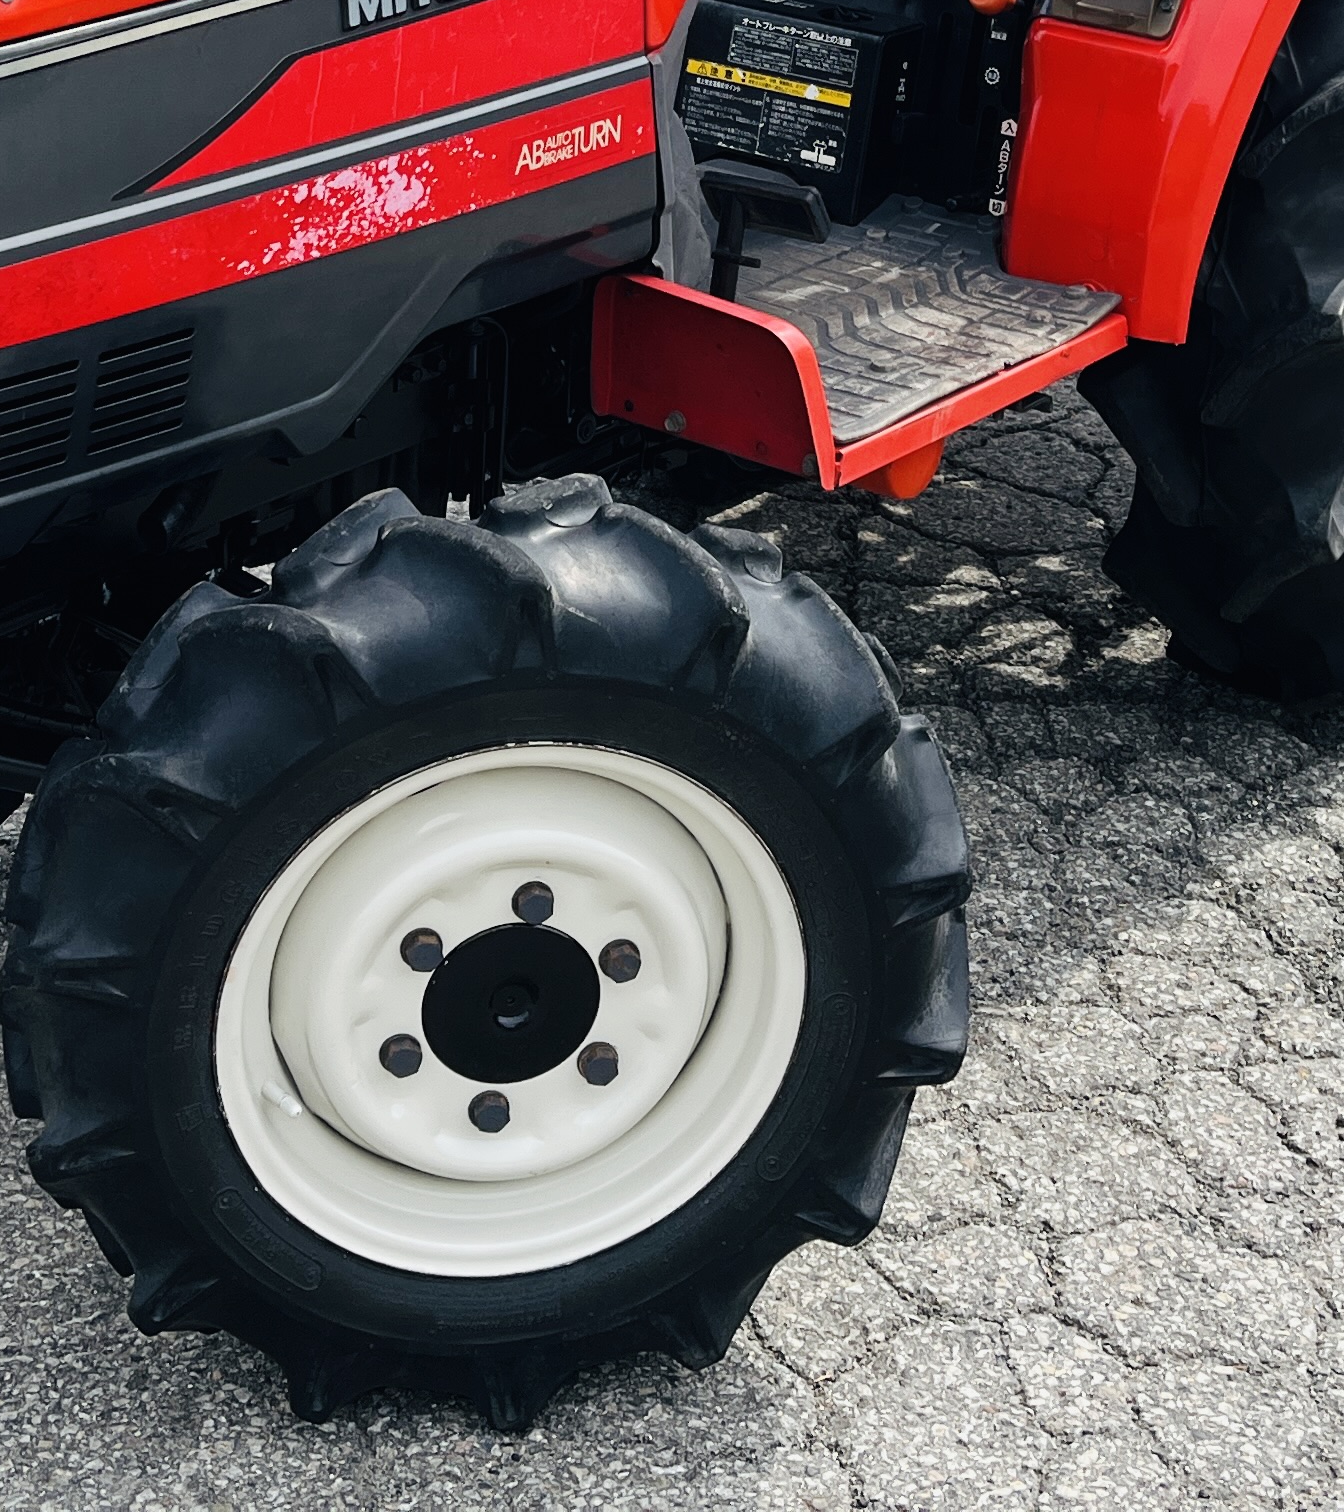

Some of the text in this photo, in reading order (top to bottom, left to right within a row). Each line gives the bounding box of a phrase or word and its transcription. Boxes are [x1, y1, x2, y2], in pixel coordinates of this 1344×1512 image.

[544, 130, 572, 150] AUTO
[572, 114, 622, 157] TURN
[543, 144, 574, 167] BRAKE
